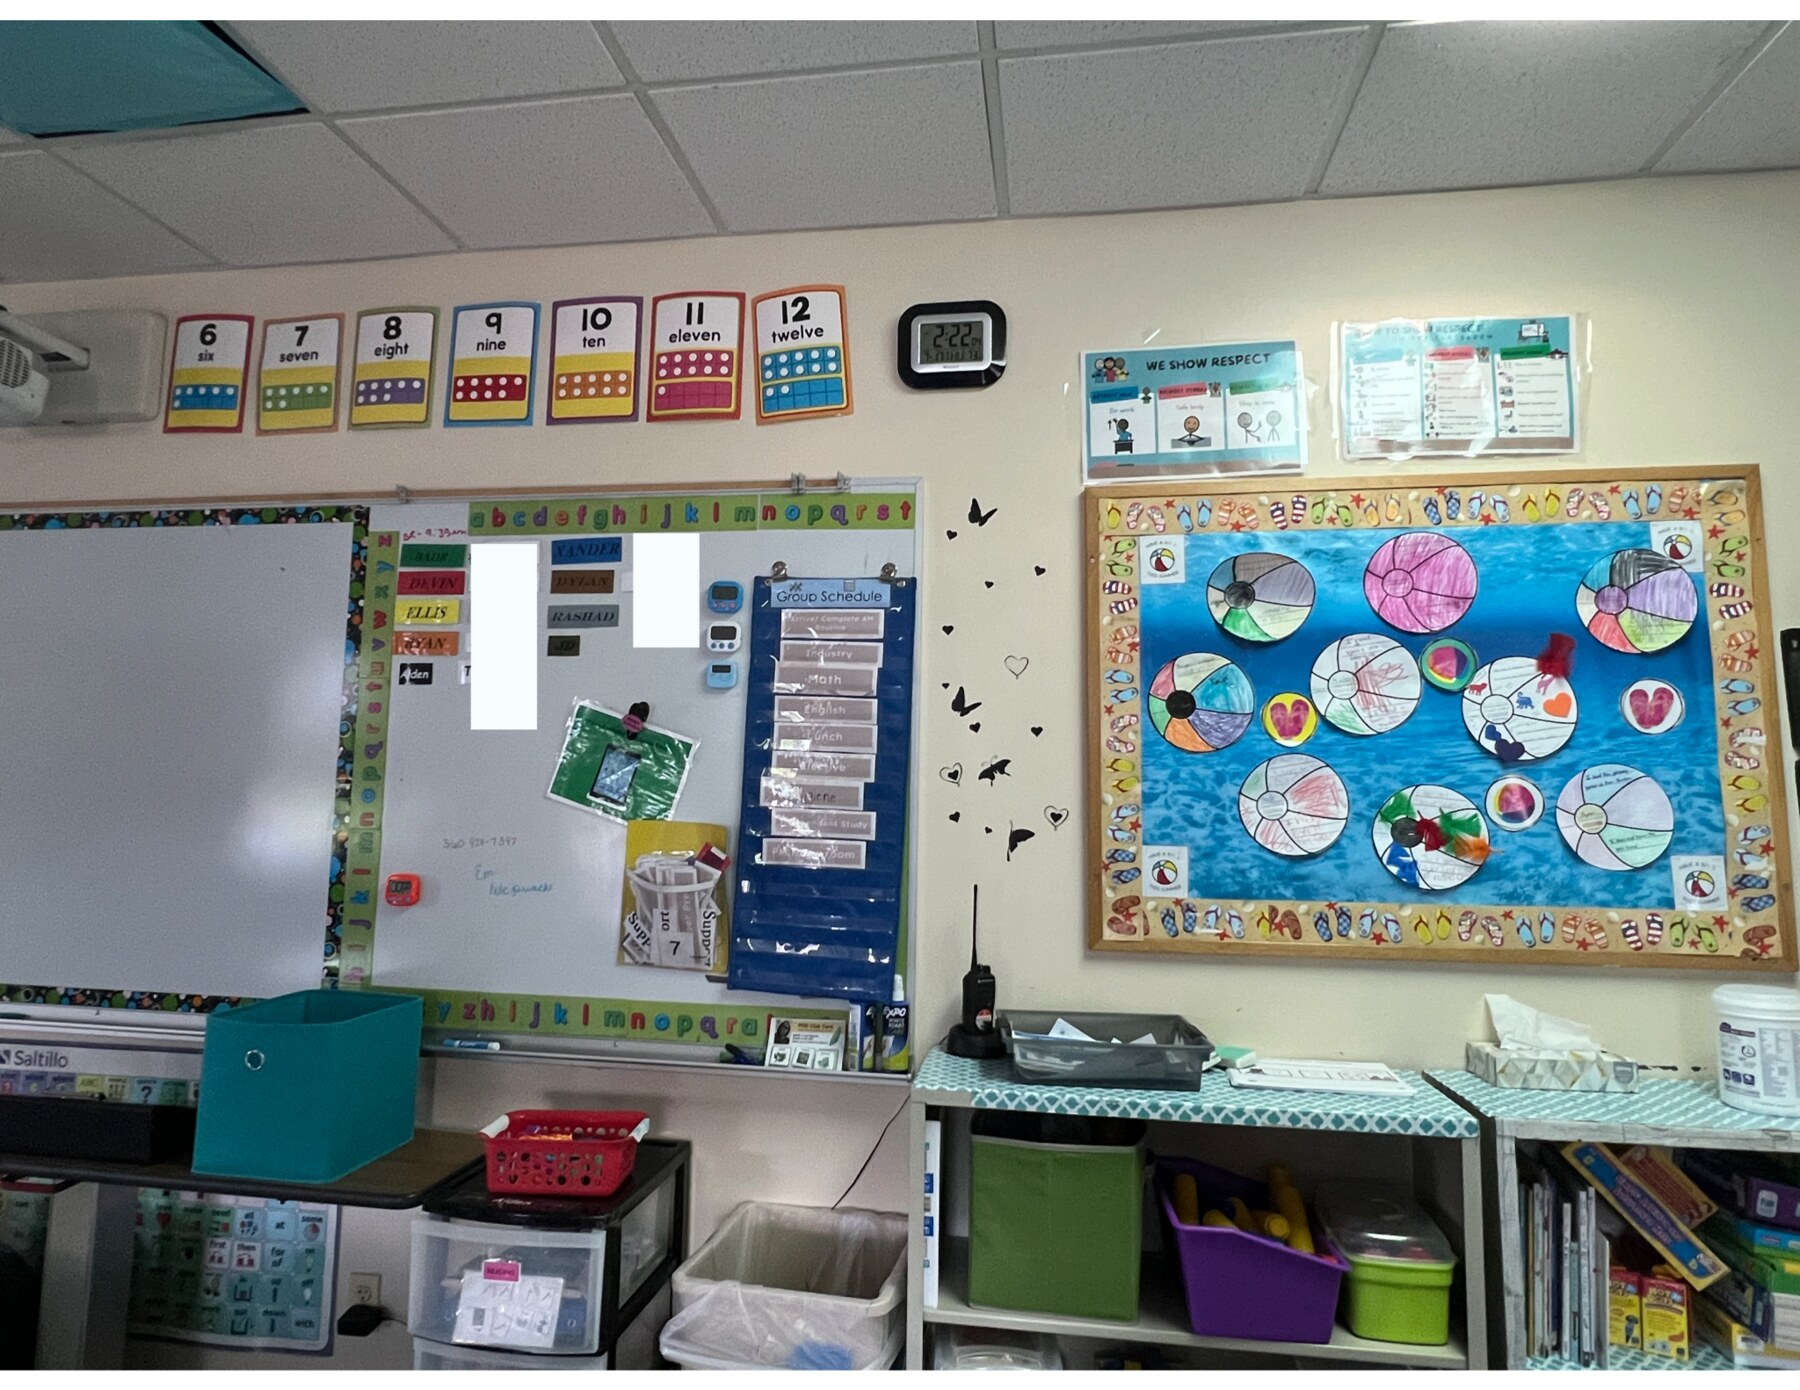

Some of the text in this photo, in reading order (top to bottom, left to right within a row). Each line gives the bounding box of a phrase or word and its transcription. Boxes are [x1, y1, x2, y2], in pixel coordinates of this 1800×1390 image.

[685, 301, 704, 326] 11
[781, 295, 812, 325] 12
[484, 312, 503, 335] 9
[581, 306, 612, 332] 10
[200, 323, 217, 346] 6
[294, 325, 310, 347] 7
[382, 316, 402, 340] 8
[669, 327, 721, 345] eleven
[771, 324, 824, 345] twelve
[476, 338, 507, 352] nine
[582, 333, 606, 349] ten
[197, 350, 215, 362] six
[279, 350, 319, 363] seven
[374, 342, 410, 359] eight
[1146, 353, 1272, 372] WE SHOW RESPECT
[409, 577, 457, 589] DEVIN
[556, 576, 610, 587] DYLAN
[777, 590, 882, 607] Group Schedule
[406, 606, 448, 619] ELLIS
[552, 611, 615, 622] RASHAD
[806, 649, 853, 659] Industry
[808, 674, 842, 685] Math
[804, 703, 846, 716] English
[670, 940, 680, 956] 7
[13, 1050, 69, 1068] Saltillo
[275, 1222, 286, 1230] at
[301, 1216, 323, 1224] some
[210, 1239, 227, 1249] first
[271, 1247, 285, 1257] for
